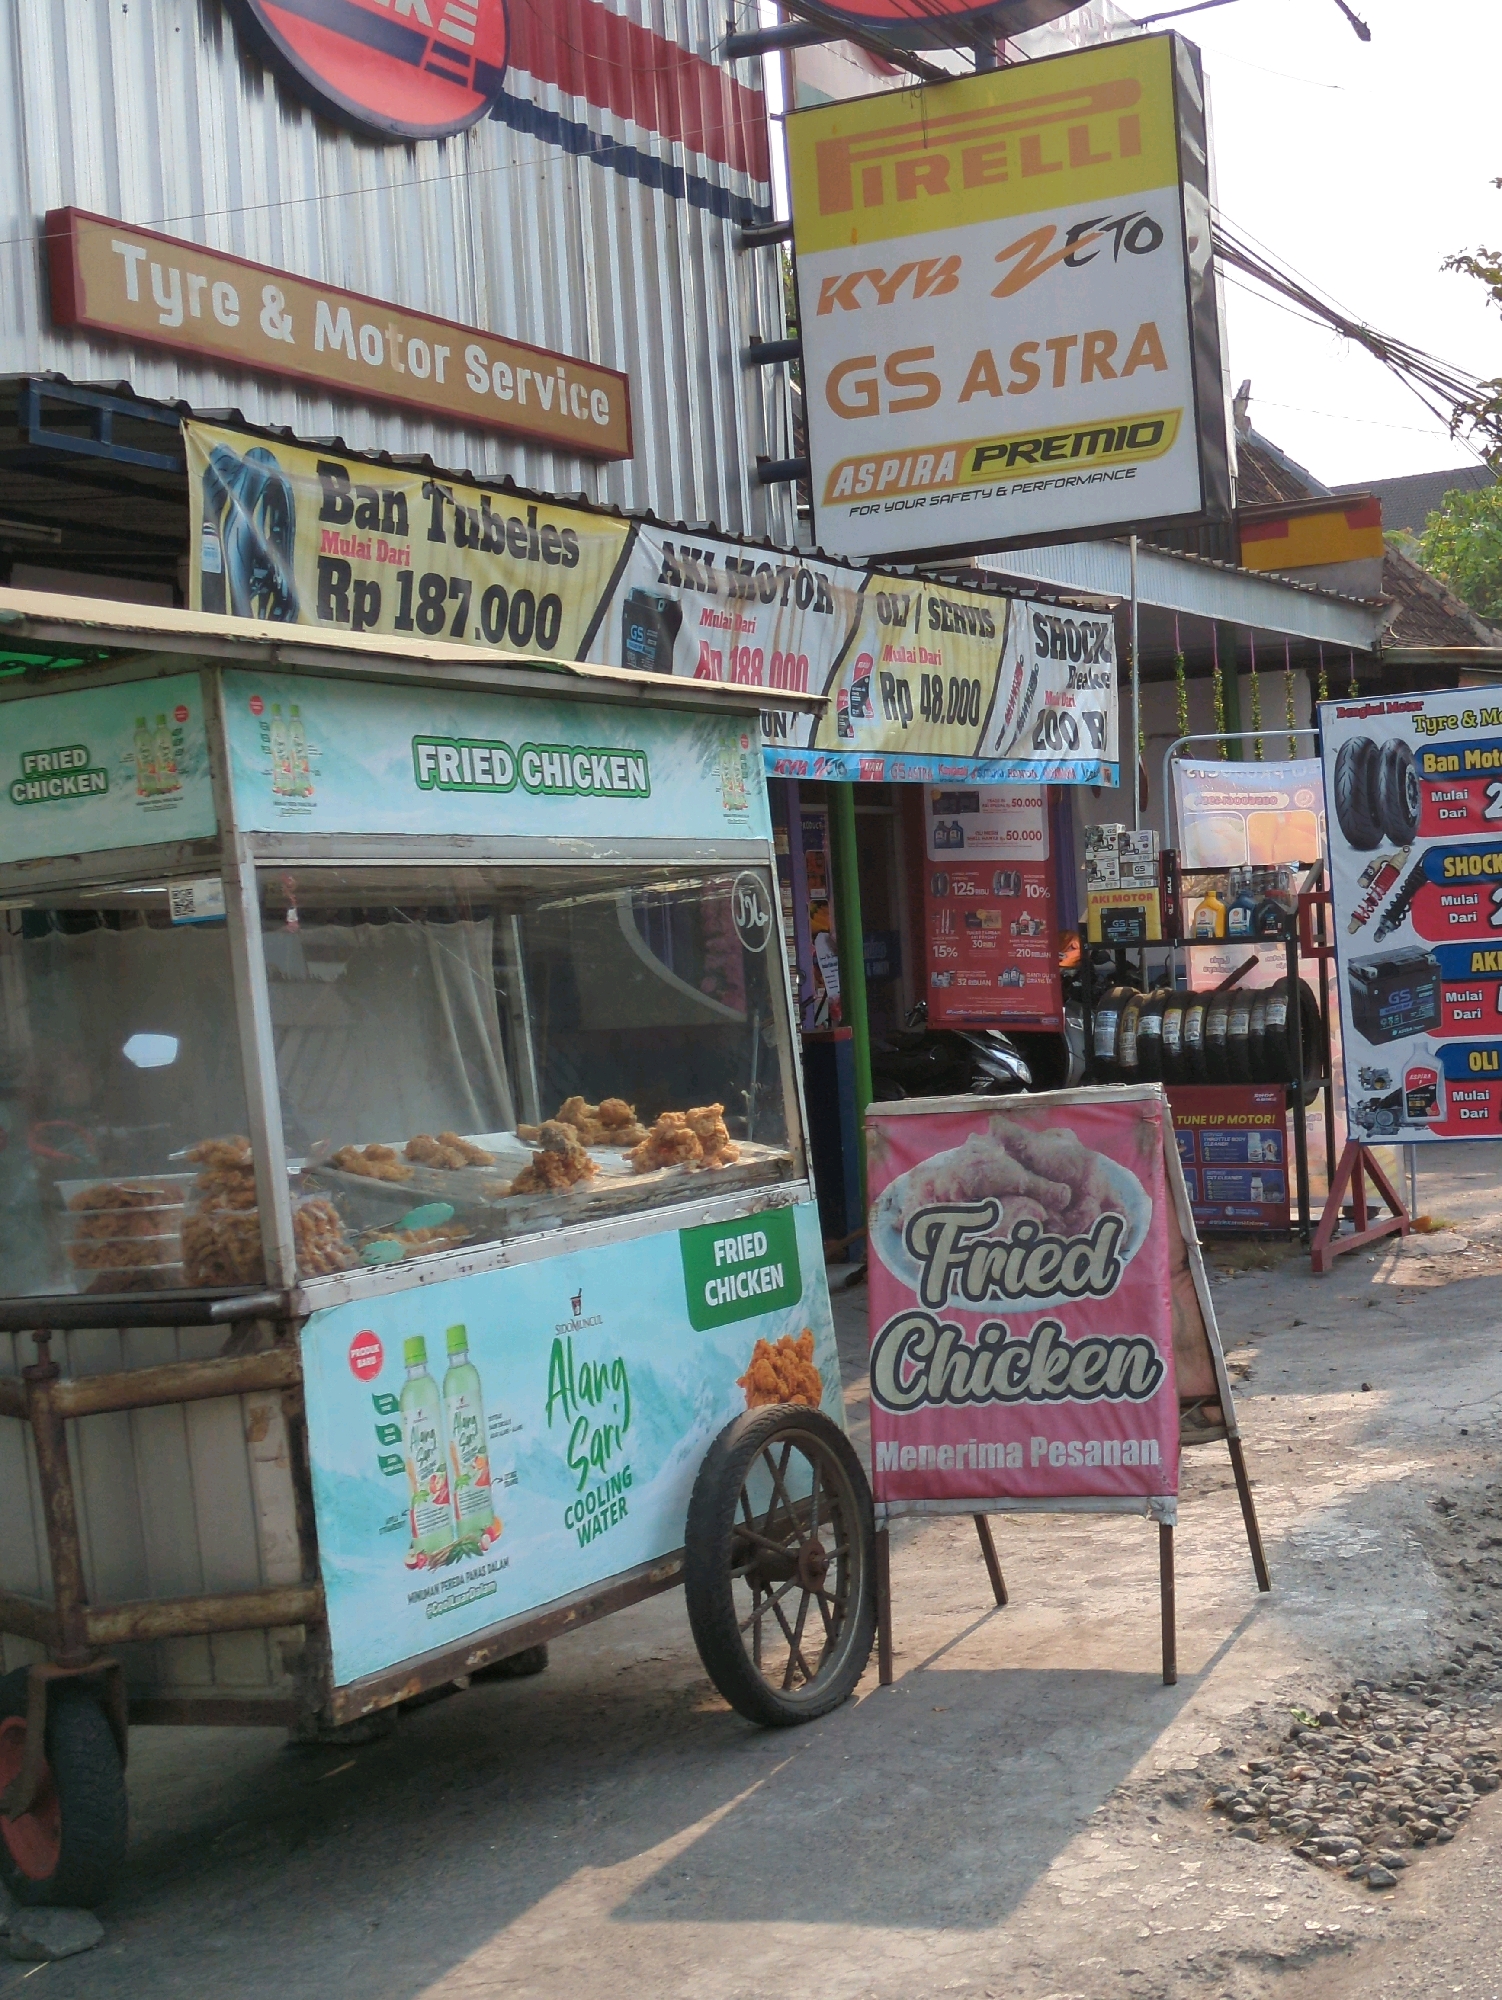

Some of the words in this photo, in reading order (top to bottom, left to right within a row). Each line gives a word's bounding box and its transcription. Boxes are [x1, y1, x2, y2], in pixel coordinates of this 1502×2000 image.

[815, 77, 1142, 216] PIRELLI
[815, 254, 963, 316] KYB
[110, 239, 241, 330] Tyre
[258, 284, 296, 345] &
[313, 299, 451, 386] Motor
[465, 343, 610, 427] Service
[824, 345, 942, 420] GS
[957, 321, 1168, 404] ASTRA
[832, 449, 957, 497] ASPIRA
[970, 415, 1165, 473] PREMIO
[849, 504, 882, 518] FOR
[884, 498, 927, 513] YOUR
[929, 489, 994, 508] SAFETY
[996, 486, 1008, 497] &
[1011, 467, 1137, 494] PERFORMANCE
[317, 460, 409, 536] Ban
[422, 481, 580, 568] Tubeles
[320, 529, 373, 562] Mulai
[375, 538, 411, 567] Dari
[316, 555, 382, 631] Rp
[395, 570, 563, 651] 187.000
[700, 607, 733, 630] Mulai
[735, 611, 757, 634] Dari
[928, 596, 996, 639] SERVIS
[919, 647, 943, 667] Dari
[880, 671, 914, 729] Rp
[920, 673, 981, 727] 48.000
[1412, 711, 1459, 736] Tyre
[1460, 710, 1478, 729] &
[24, 748, 88, 773] FRIED
[417, 744, 515, 785] FRIED
[521, 752, 648, 791] CHICKEN
[1423, 753, 1460, 773] Ban
[1464, 748, 1502, 770] Mot
[11, 771, 107, 802] CHICKEN
[1431, 789, 1469, 802] Mulai
[1011, 797, 1043, 808] 50.000
[1439, 807, 1468, 819] Dari
[1006, 830, 1042, 841] 50.000
[952, 882, 975, 895] 125
[1024, 884, 1051, 898] 10%
[1091, 896, 1111, 904] AKI
[1113, 893, 1154, 903] MOTOR
[1440, 893, 1480, 907] Mulai
[1112, 919, 1126, 928] GS
[1449, 911, 1478, 924] Dari
[932, 945, 959, 958] 15%
[1016, 948, 1031, 958] 210
[957, 978, 968, 986] 32
[1445, 989, 1484, 1003] Mulai
[1453, 1007, 1482, 1020] Dari
[1469, 1051, 1499, 1072] OLI
[1452, 1089, 1490, 1102] Mulai
[1176, 1115, 1207, 1125] TUNE
[1209, 1114, 1226, 1124] UP
[1226, 1114, 1276, 1125] MOTOR!
[1460, 1107, 1489, 1119] Dari
[713, 1232, 768, 1267] FRIED
[905, 1198, 1127, 1310] Fried
[704, 1263, 784, 1306] CHICKEN
[350, 1342, 380, 1359] PRODUK
[356, 1356, 377, 1369] BARU
[871, 1310, 1165, 1411] Chicken
[546, 1335, 631, 1434] Alang
[567, 1403, 623, 1492] Sari
[876, 1439, 1023, 1472] Menerima
[1030, 1436, 1160, 1468] Pesanan
[564, 1465, 633, 1529] COOLING
[576, 1496, 629, 1548] WATER
[487, 1556, 510, 1574] DALAM
